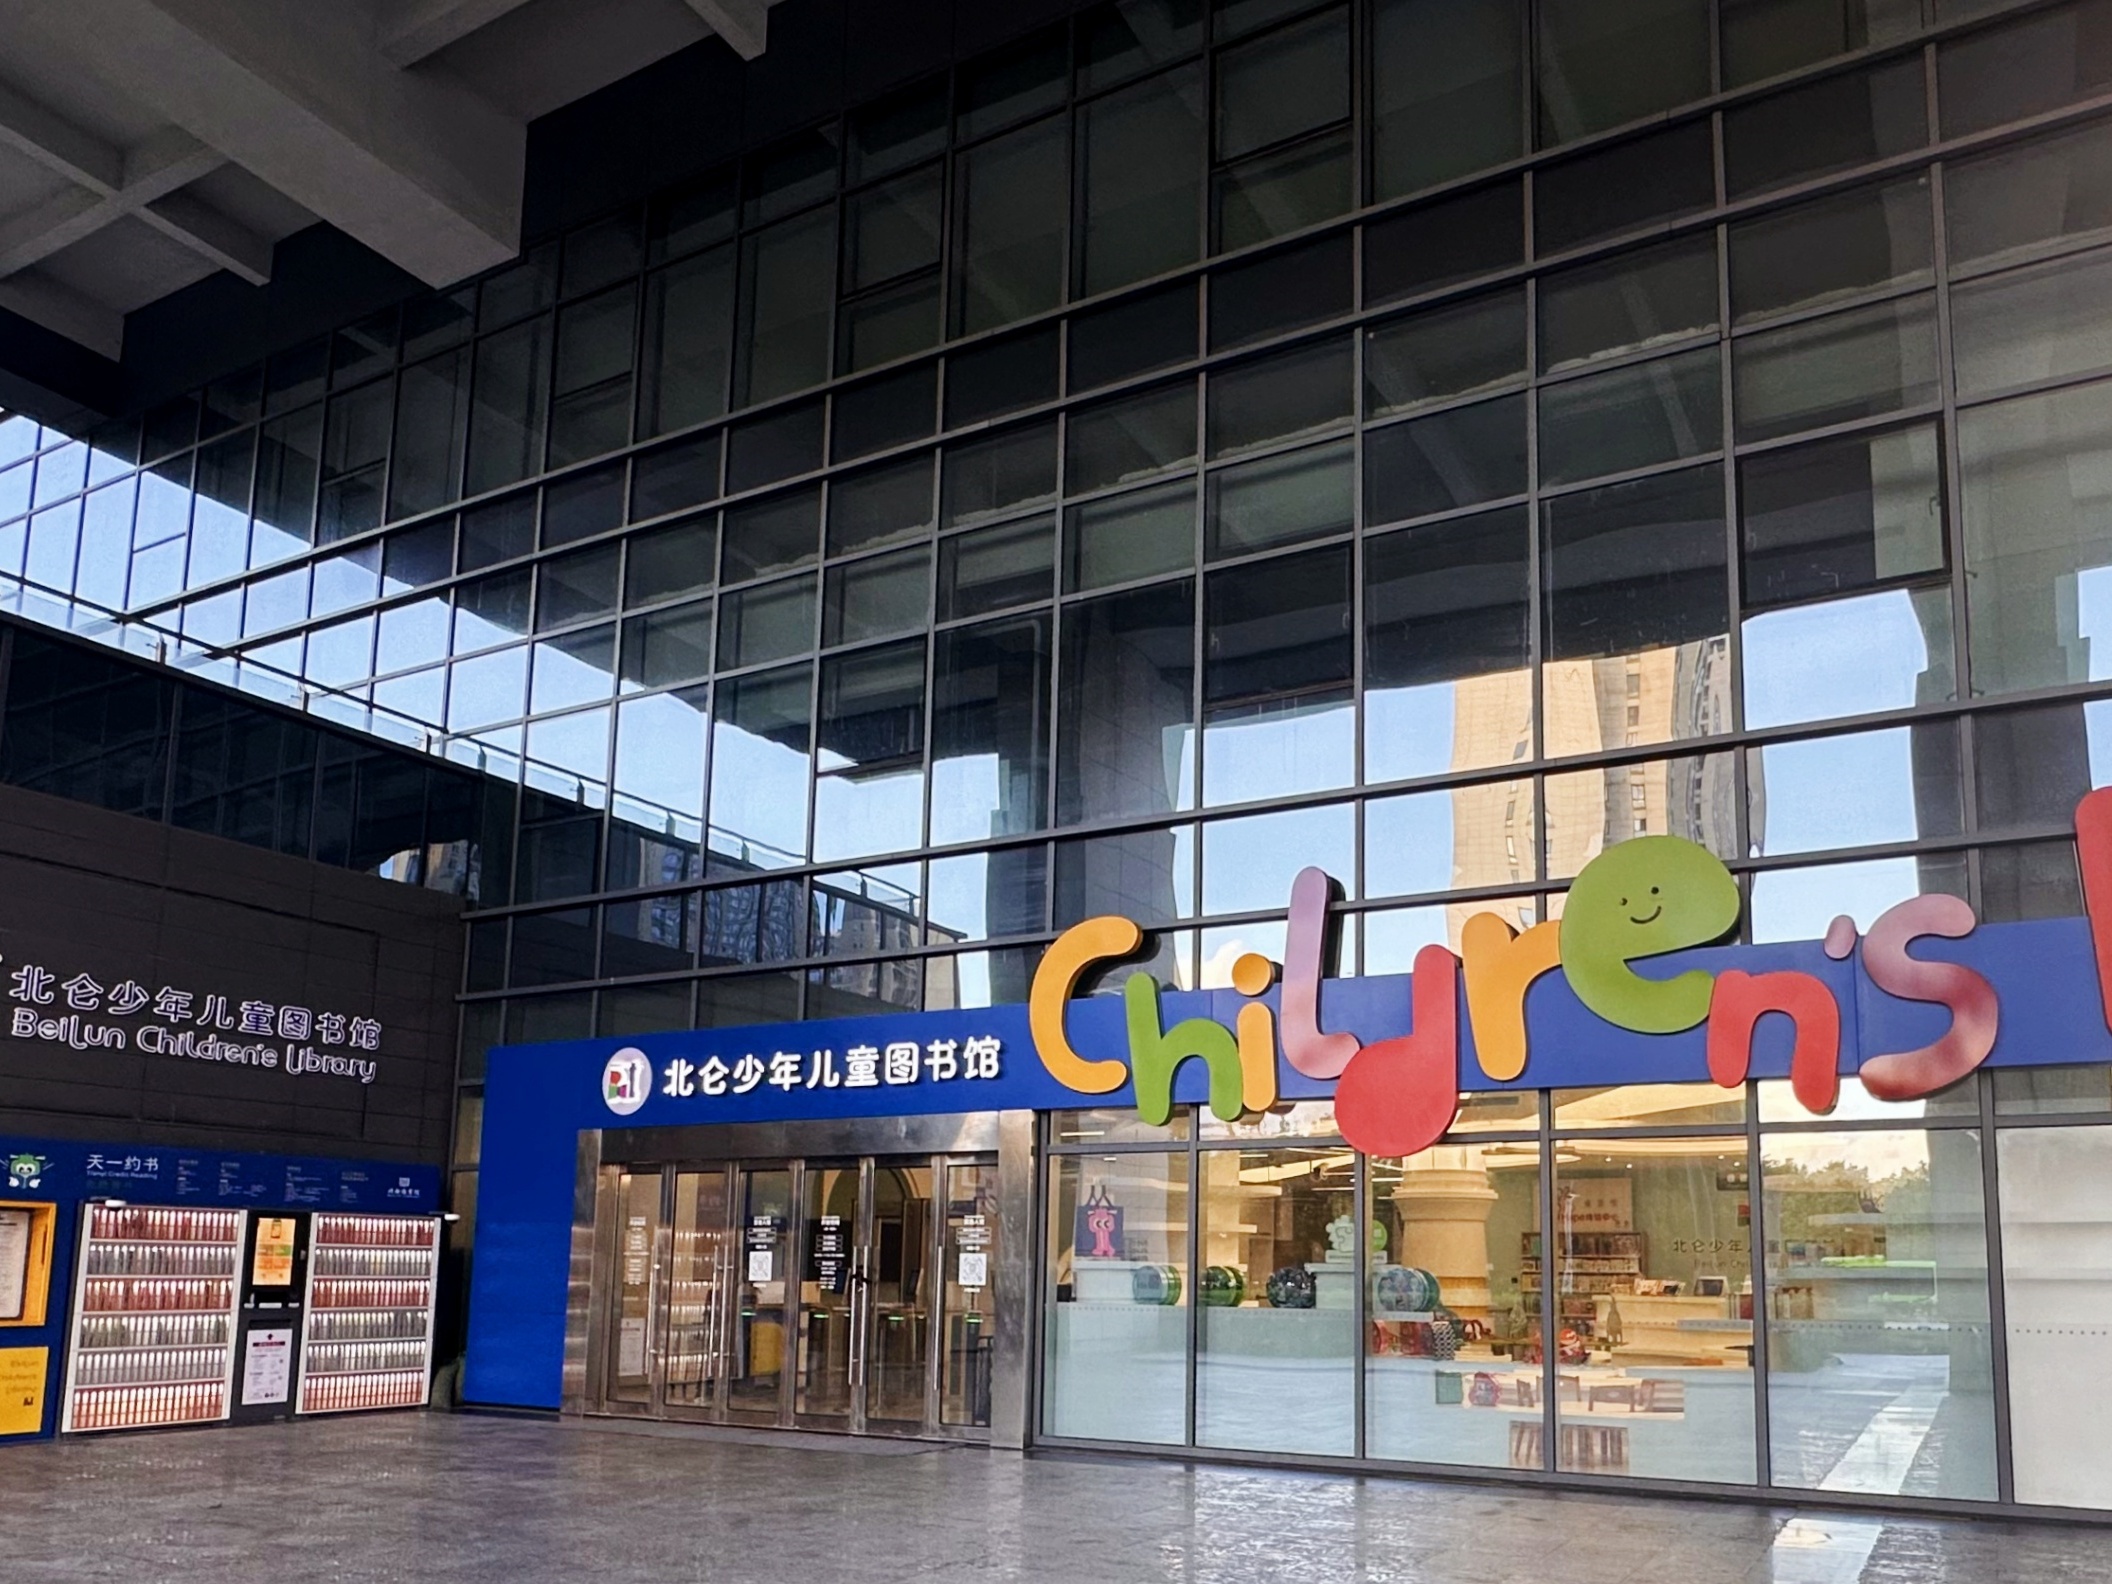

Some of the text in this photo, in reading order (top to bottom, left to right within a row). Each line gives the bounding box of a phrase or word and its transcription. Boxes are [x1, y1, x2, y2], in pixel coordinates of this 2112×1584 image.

[9, 965, 382, 1050] 北仑少年儿童图书馆
[662, 1035, 1002, 1098] 北仑少年儿童图书馆
[86, 1154, 159, 1172] 天一约书
